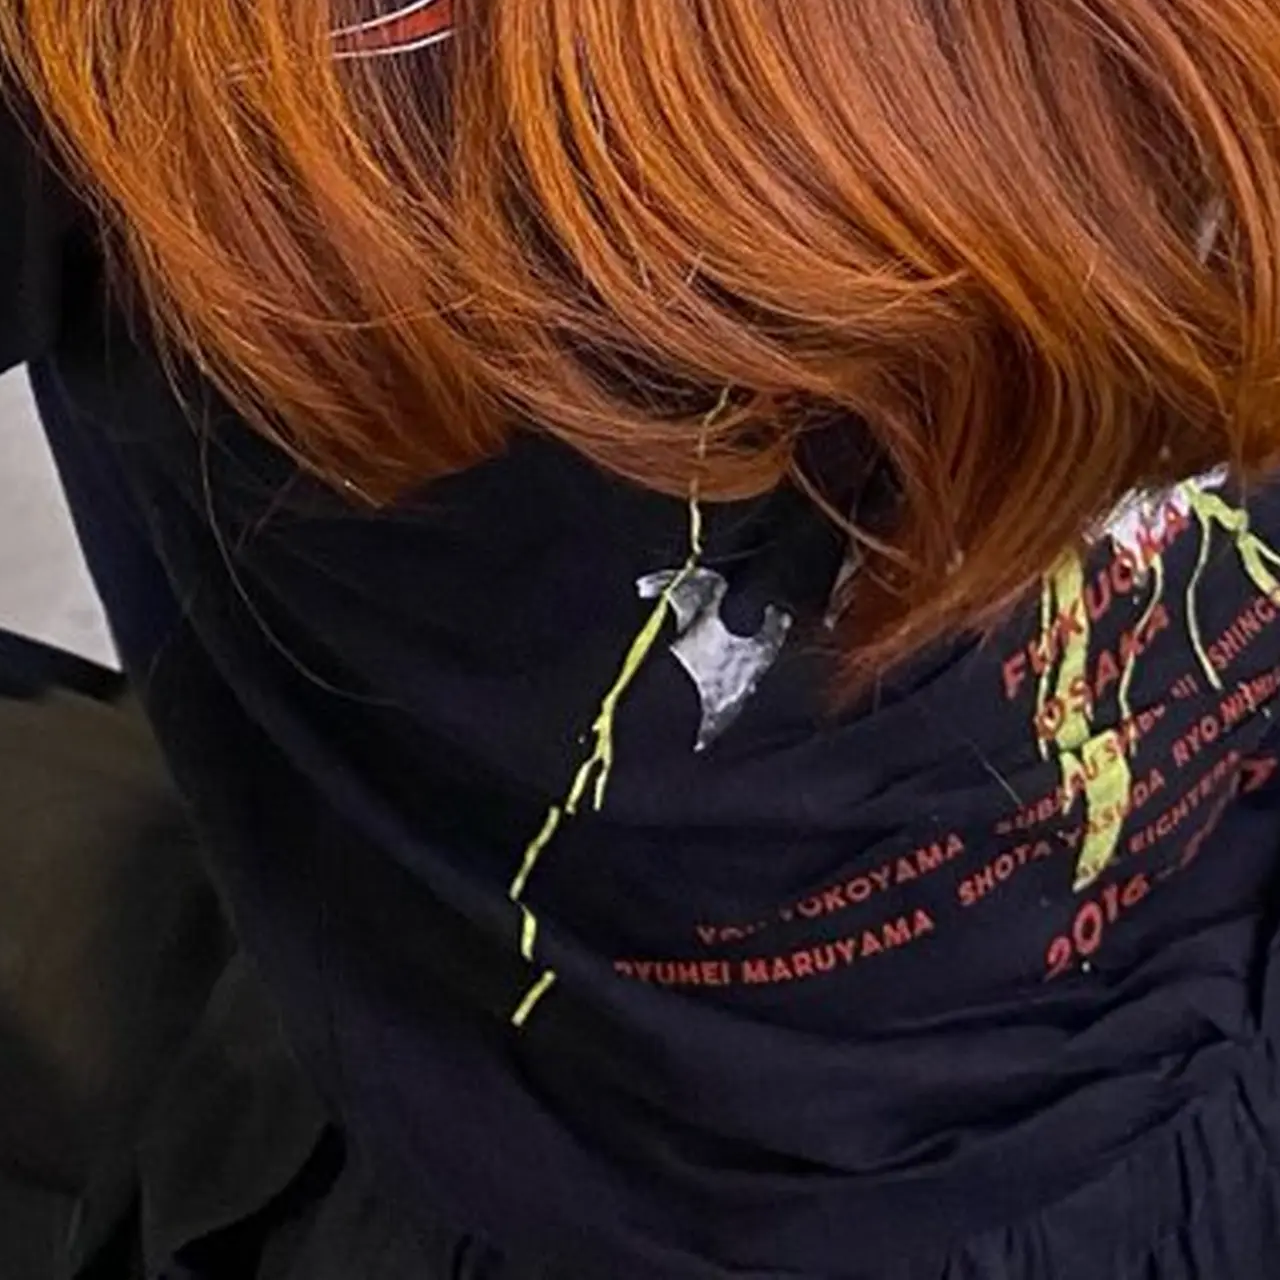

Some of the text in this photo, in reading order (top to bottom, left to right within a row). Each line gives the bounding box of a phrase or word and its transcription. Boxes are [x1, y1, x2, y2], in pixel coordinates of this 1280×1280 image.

[1002, 502, 1188, 699] FUKUOKA
[742, 908, 935, 984] MARUYAMA
[957, 841, 1053, 907] SHOTA
[1172, 714, 1219, 768] RYO
